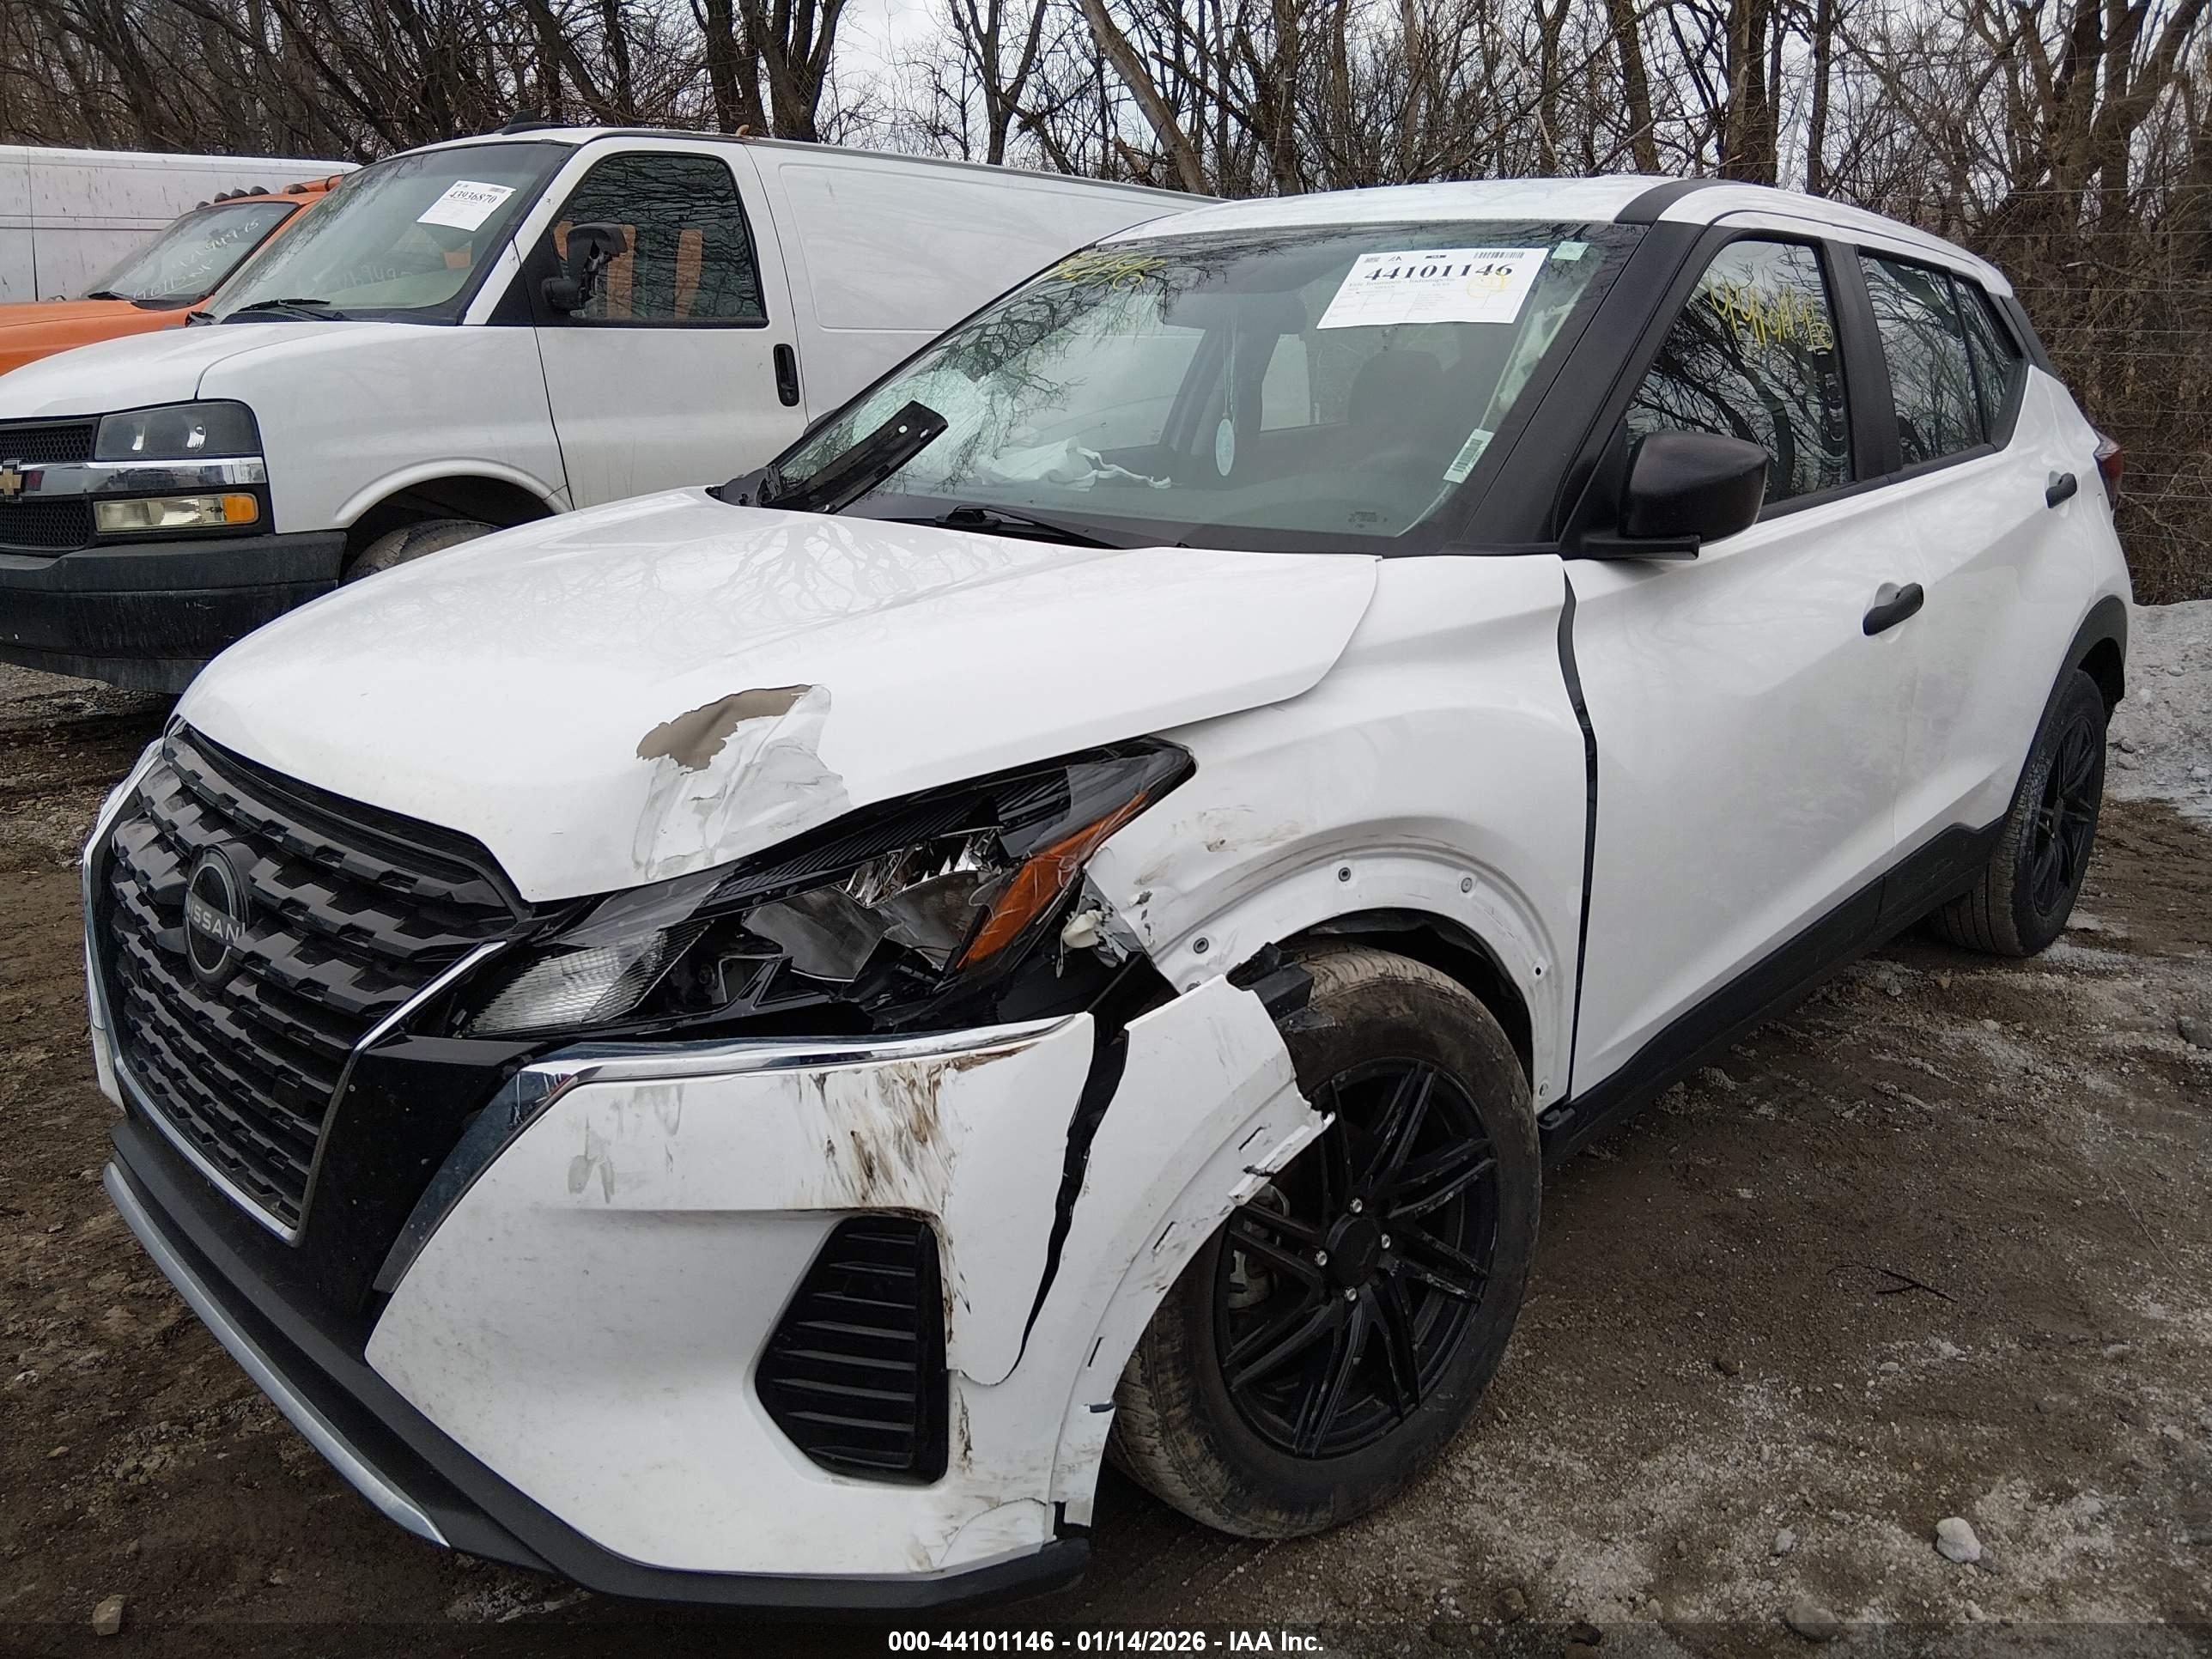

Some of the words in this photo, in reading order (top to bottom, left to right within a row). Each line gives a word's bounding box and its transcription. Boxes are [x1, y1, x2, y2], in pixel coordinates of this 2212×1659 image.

[448, 190, 497, 204] 43936870
[1364, 263, 1516, 281] 44101146
[185, 893, 240, 942] NISSAN
